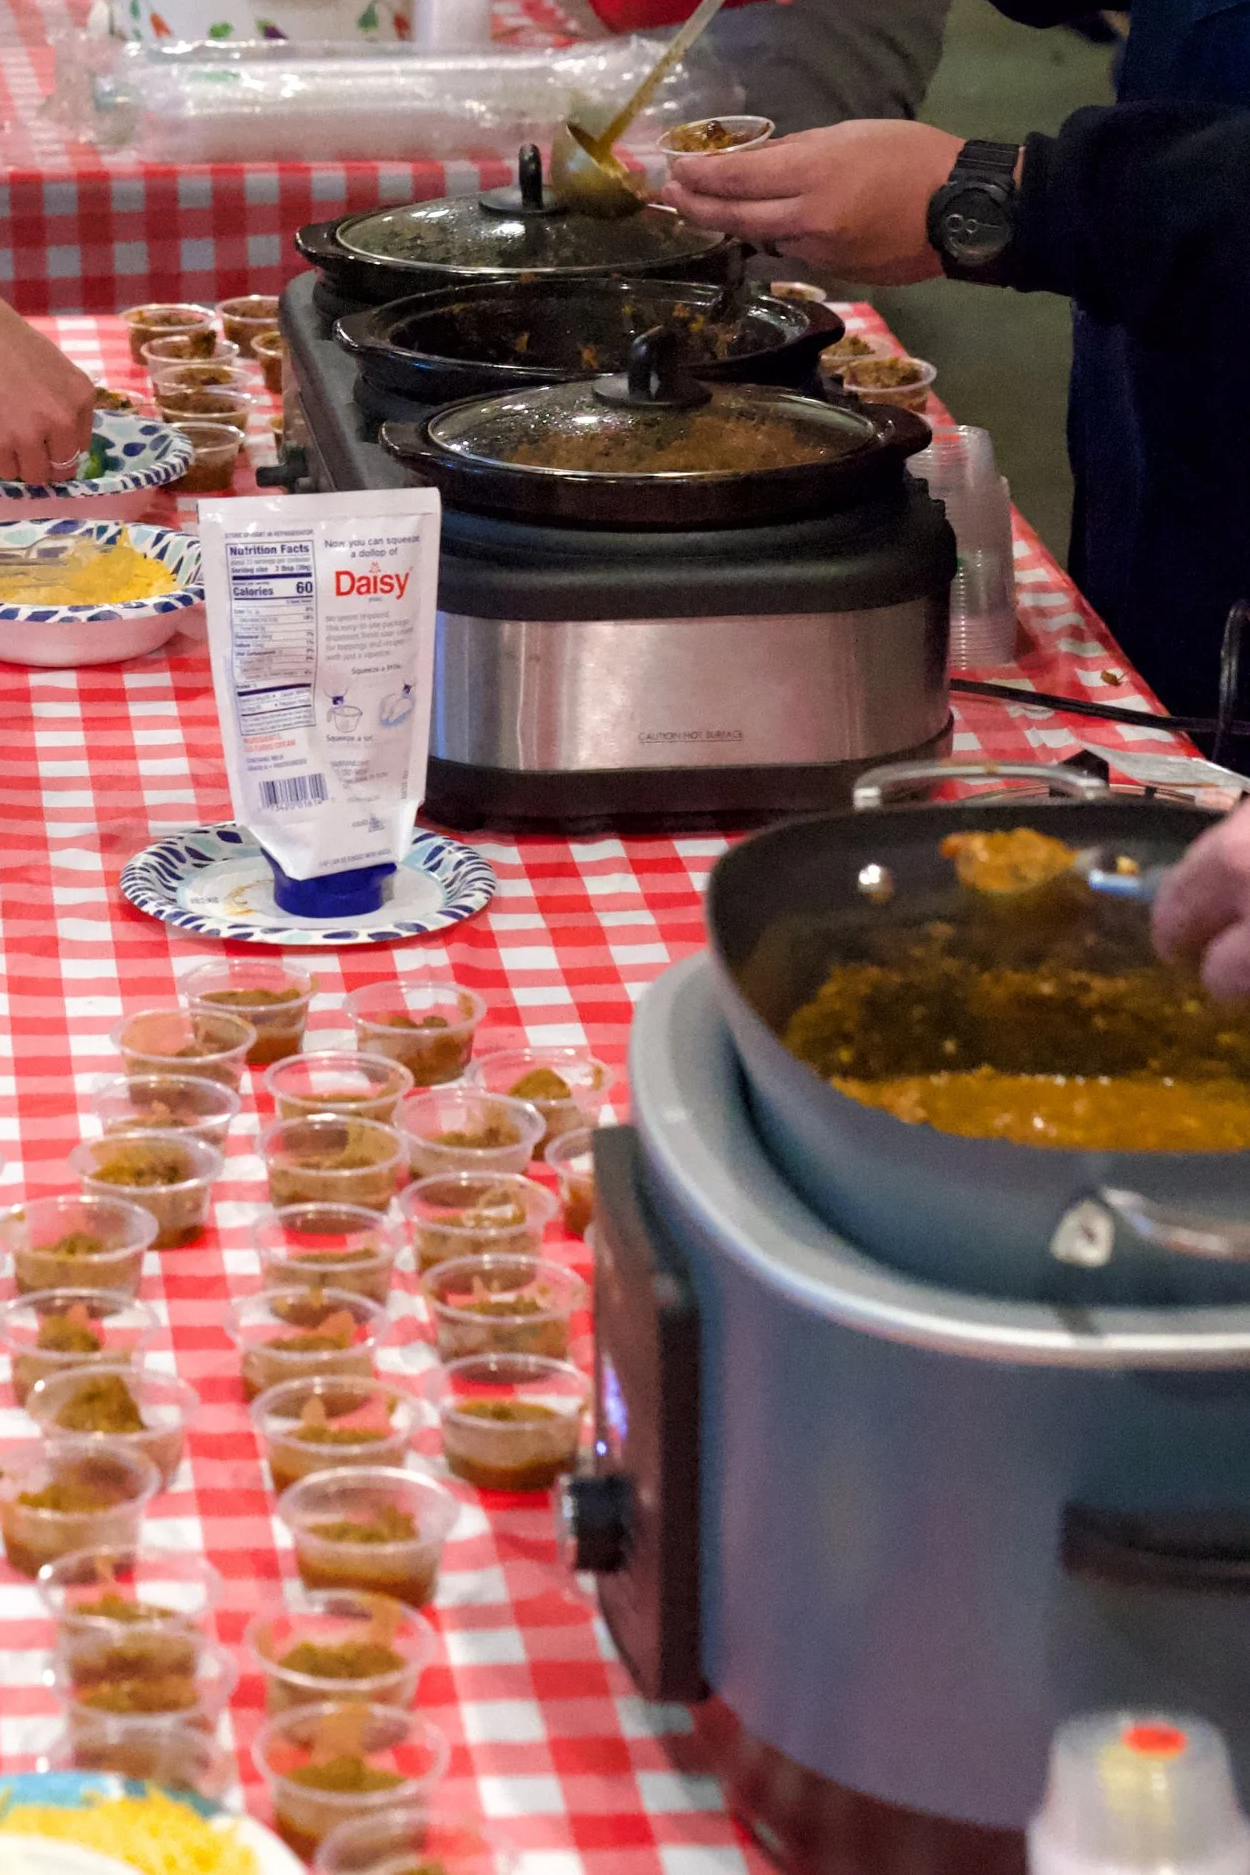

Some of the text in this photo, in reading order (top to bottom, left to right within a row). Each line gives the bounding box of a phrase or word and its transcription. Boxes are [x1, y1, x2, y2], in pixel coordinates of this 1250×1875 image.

[324, 534, 420, 548] Now you can squeeze
[229, 544, 310, 556] Nutrition Facts
[359, 549, 386, 558] dollop
[389, 548, 398, 556] of
[233, 581, 313, 596] Calories 60
[334, 570, 410, 600] Daisy
[351, 667, 379, 675] Squeeze
[638, 730, 742, 741] CAUTION HOT SURFACE
